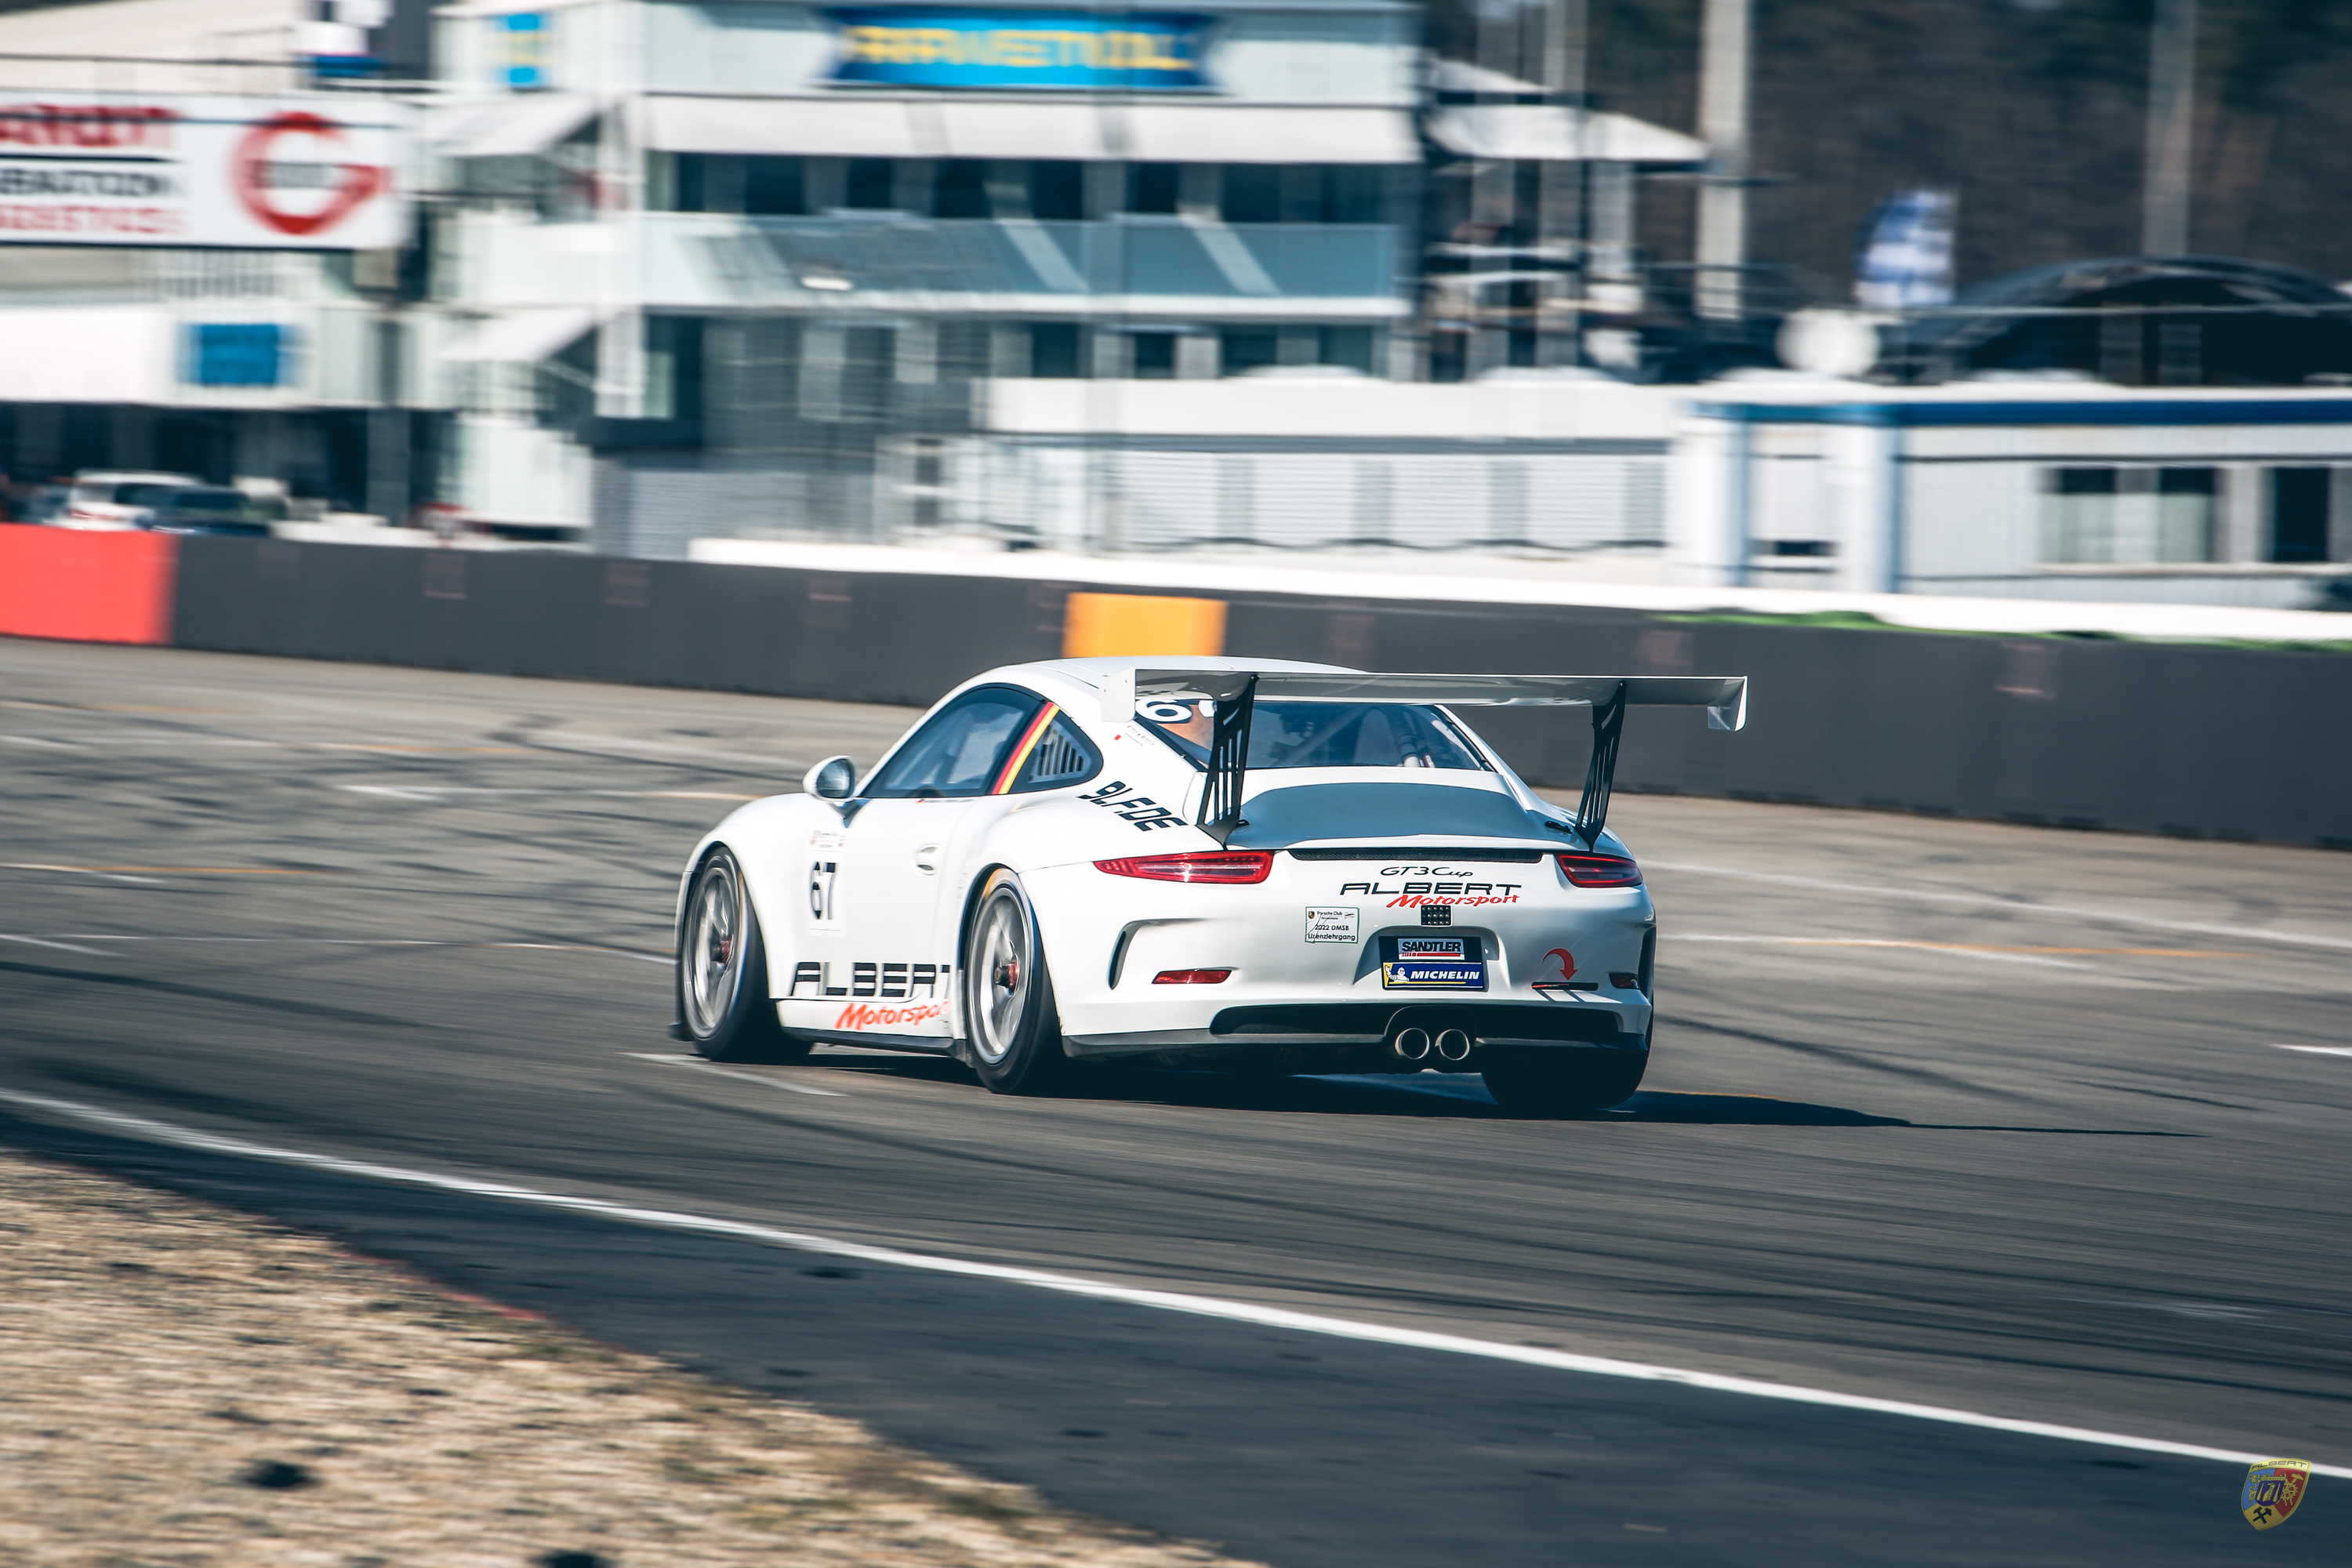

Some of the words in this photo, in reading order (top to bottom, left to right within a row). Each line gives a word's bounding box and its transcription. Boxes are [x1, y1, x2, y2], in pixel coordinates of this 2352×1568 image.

[809, 861, 837, 920] 67
[1340, 882, 1522, 896] ALBERT
[1386, 895, 1520, 909] Motorsport
[1402, 941, 1461, 953] SANDTLER
[1410, 971, 1479, 980] MICHELIN
